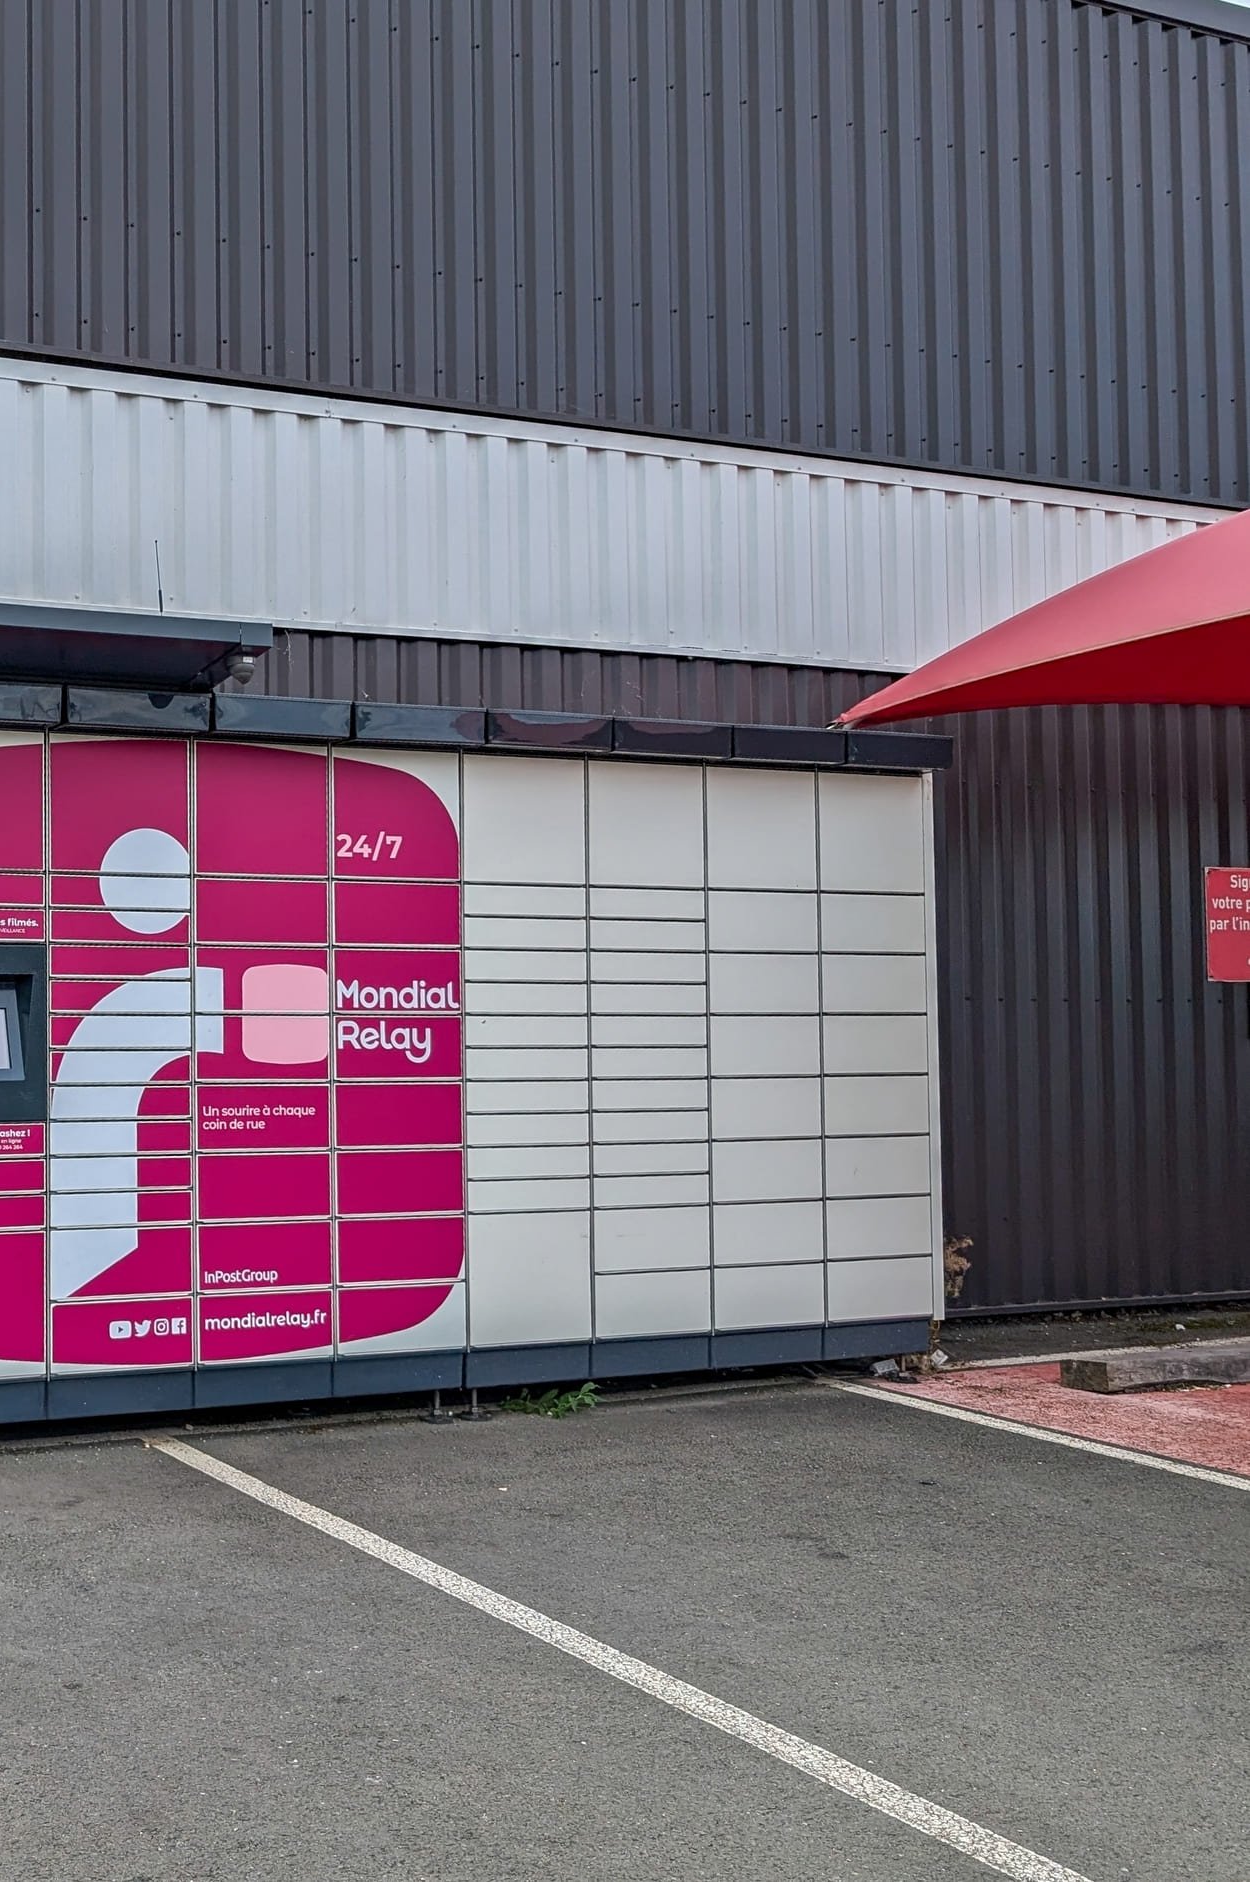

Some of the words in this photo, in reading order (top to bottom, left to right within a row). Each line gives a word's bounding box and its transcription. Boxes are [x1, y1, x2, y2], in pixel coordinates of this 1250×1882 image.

[336, 831, 403, 861] 24/7
[1212, 896, 1243, 909] votre
[7, 917, 38, 927] filmés.
[1210, 919, 1229, 933] par
[336, 979, 460, 1009] Mondial
[337, 1020, 431, 1063] Relay
[203, 1106, 219, 1116] Un
[221, 1105, 260, 1116] sourire
[262, 1105, 270, 1116] à
[272, 1105, 316, 1118] chaque
[202, 1119, 227, 1130] coin
[229, 1119, 244, 1130] de
[246, 1120, 266, 1129] rue
[27, 1129, 31, 1137] !
[204, 1269, 278, 1284] InPostGroup
[204, 1309, 327, 1331] mondialrelay.fr
